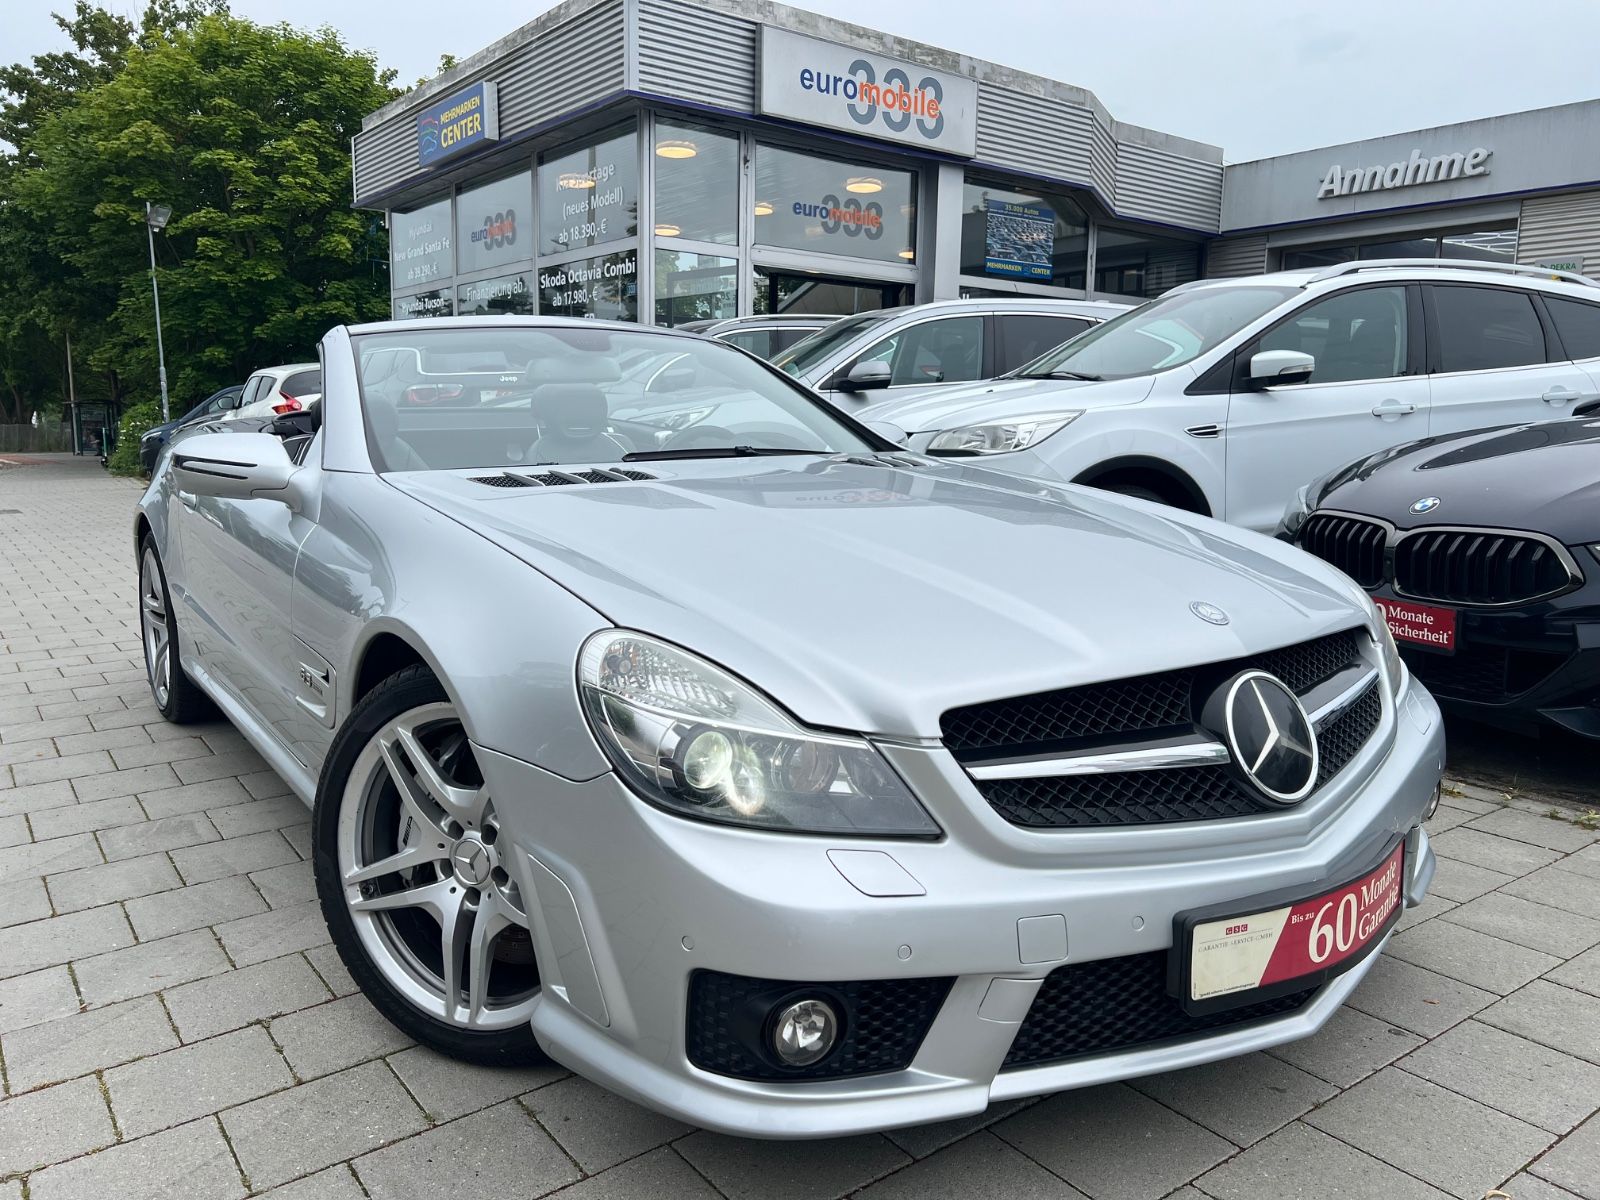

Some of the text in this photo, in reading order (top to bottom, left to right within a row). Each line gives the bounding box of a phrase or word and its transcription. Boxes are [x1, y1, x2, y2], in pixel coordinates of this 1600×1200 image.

[800, 68, 941, 118] euromobile
[440, 96, 480, 125] MEHRMARKEN
[441, 113, 481, 148] CENTER
[1317, 147, 1488, 199] Annahme
[563, 186, 623, 220] (neues Modell)
[407, 245, 424, 260] Grand
[424, 240, 441, 254] Santa
[442, 237, 450, 249] Fe
[559, 229, 568, 243] ab
[540, 257, 636, 289] Skoda Octavia Combi
[1031, 267, 1051, 275] CENTER
[1551, 262, 1577, 271] DEKRA
[466, 277, 523, 302] Finanzierung ab
[552, 294, 562, 307] ab
[401, 298, 444, 315] Hyundai Tucson
[1388, 605, 1434, 625] Monate
[1360, 861, 1397, 912] Monate
[1291, 911, 1315, 924] Bis zu
[1358, 883, 1399, 940] Garantie
[1308, 893, 1358, 963] 60
